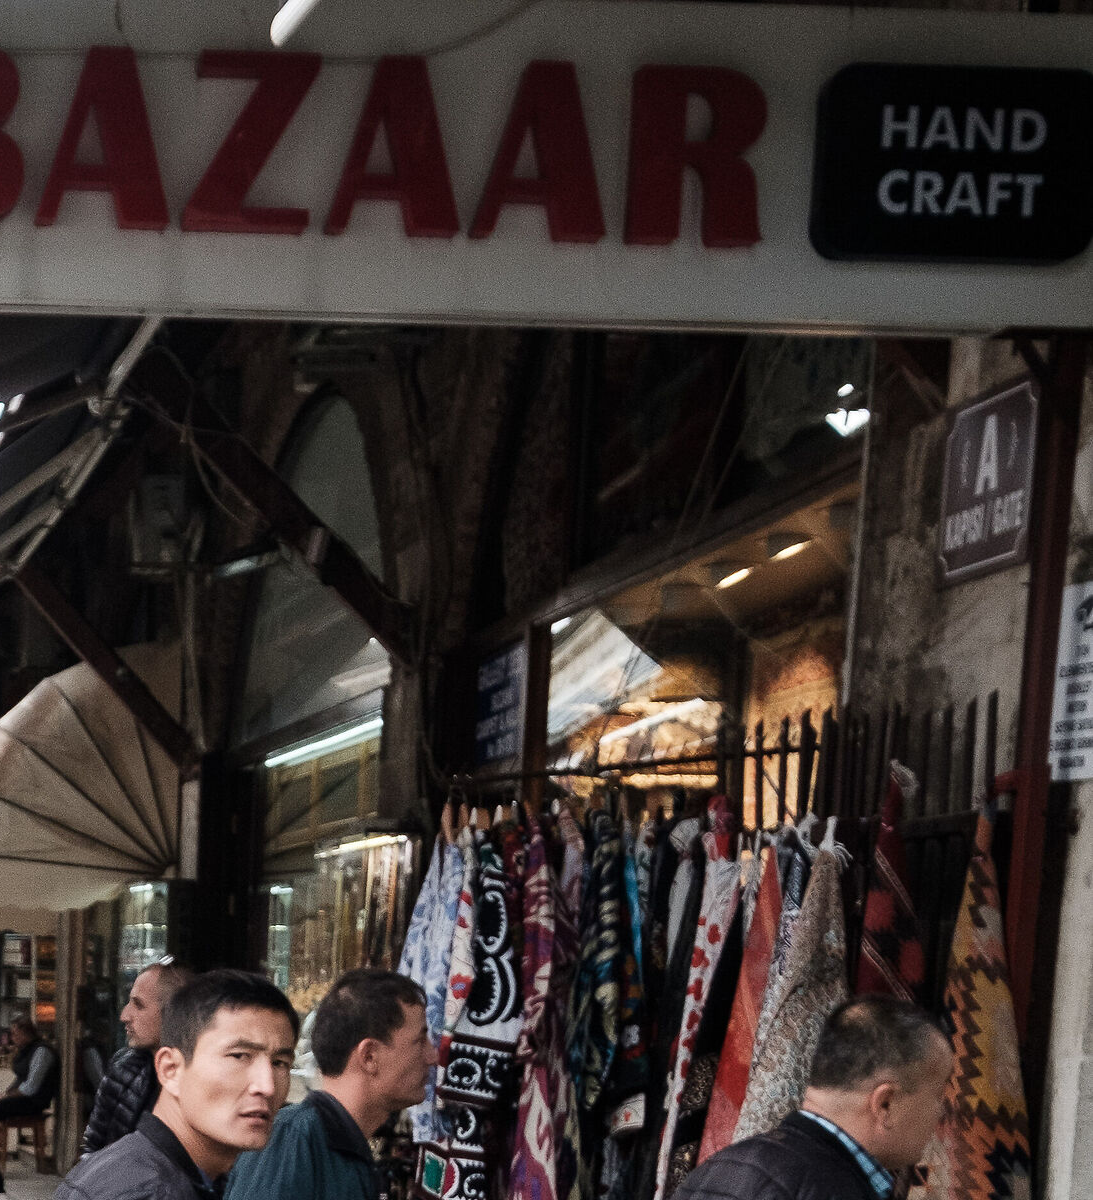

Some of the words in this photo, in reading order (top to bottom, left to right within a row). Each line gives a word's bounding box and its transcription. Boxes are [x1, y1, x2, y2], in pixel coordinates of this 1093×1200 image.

[881, 103, 1048, 152] HAND
[877, 169, 1044, 218] CRAFT
[974, 414, 999, 495] A
